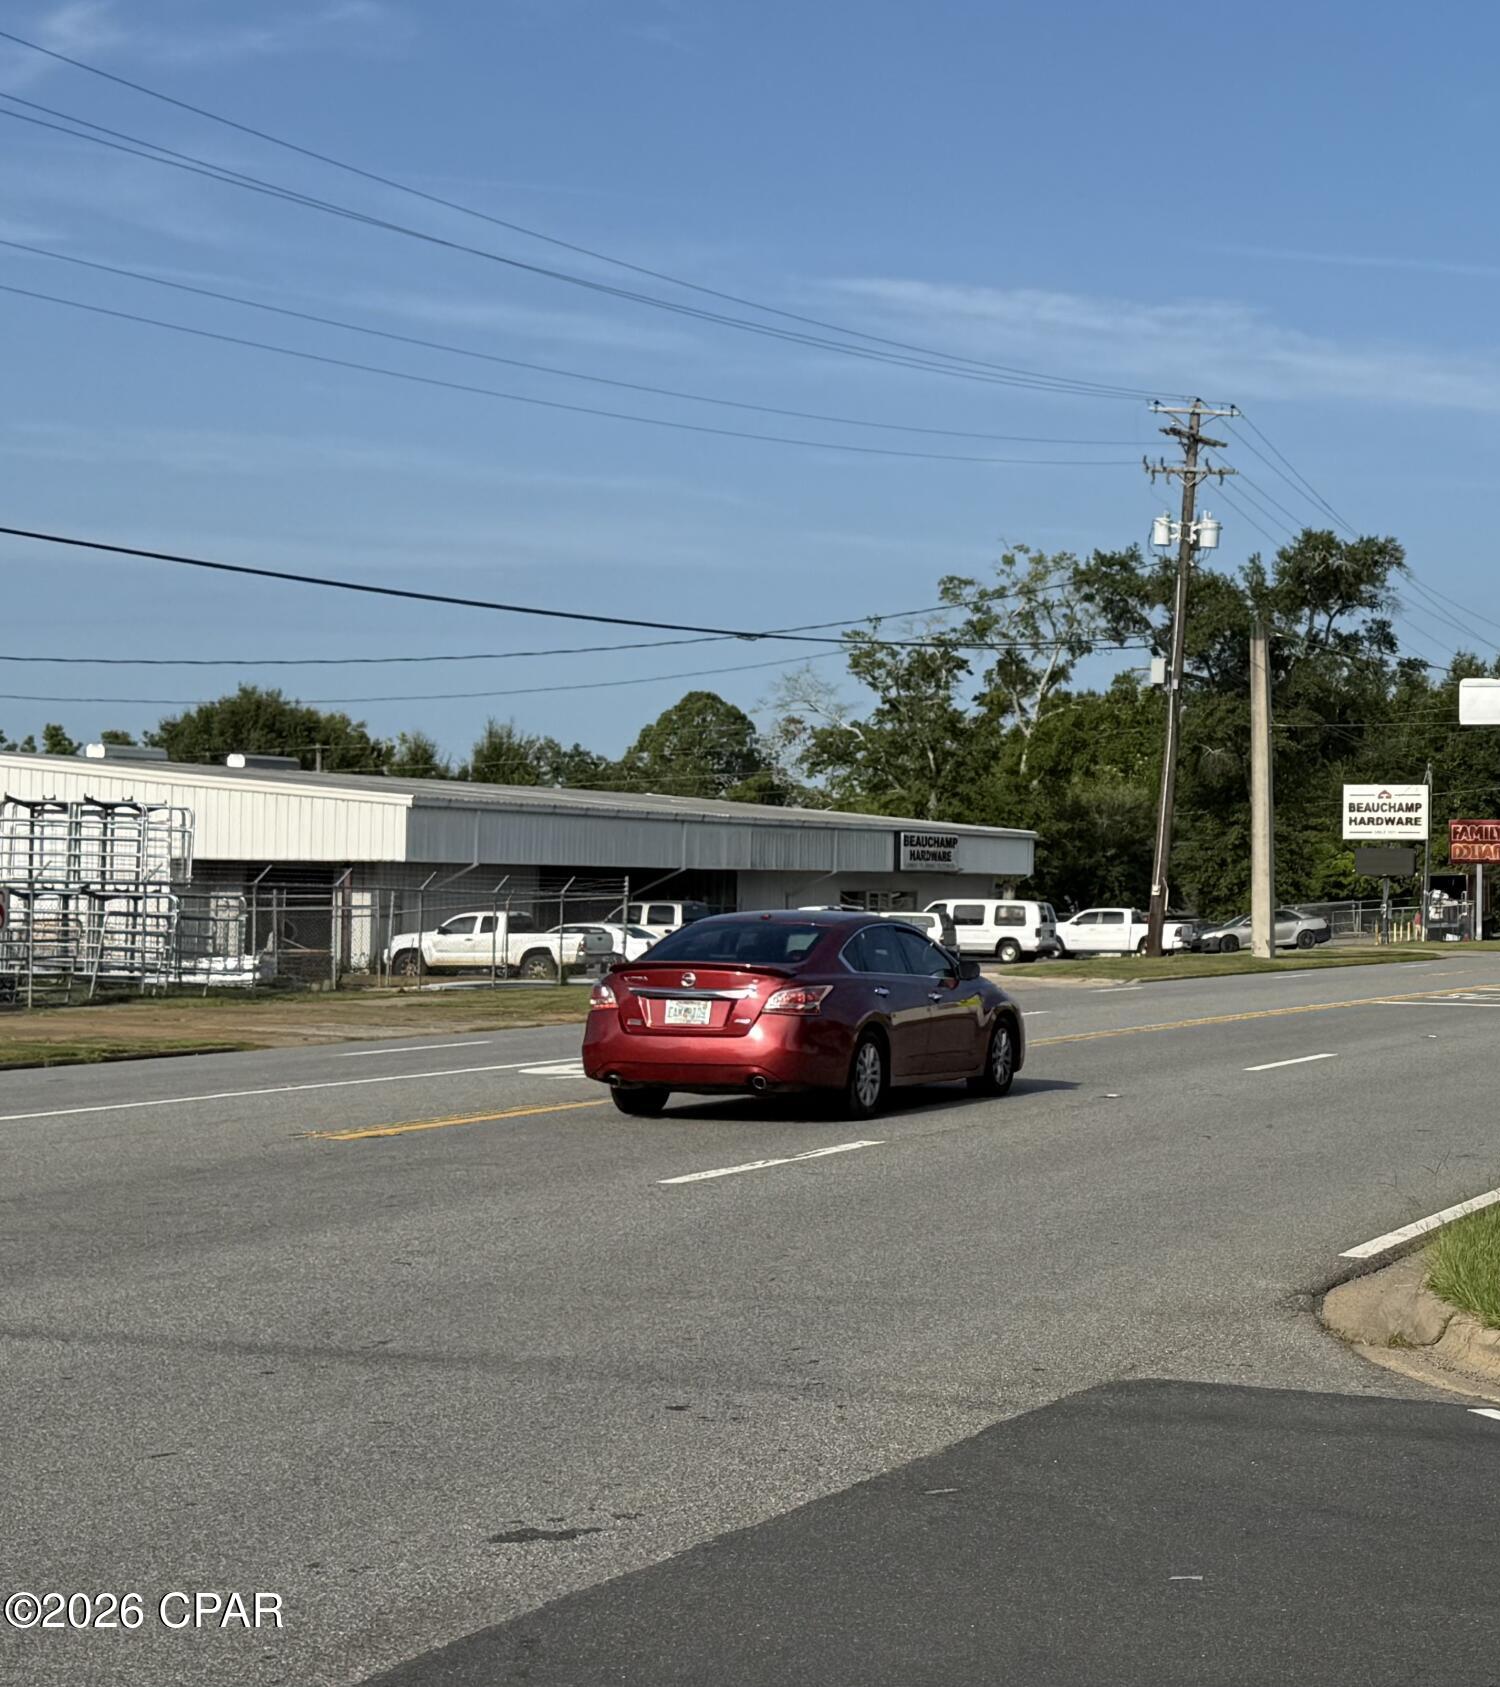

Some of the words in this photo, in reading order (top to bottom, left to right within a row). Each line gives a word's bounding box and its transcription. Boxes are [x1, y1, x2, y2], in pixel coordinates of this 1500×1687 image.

[1348, 802, 1423, 813] BEAUCHAMP
[1348, 816, 1423, 826] HARDWARE
[903, 834, 958, 849] BEAUCHAMP
[909, 849, 952, 862] HARDWARE
